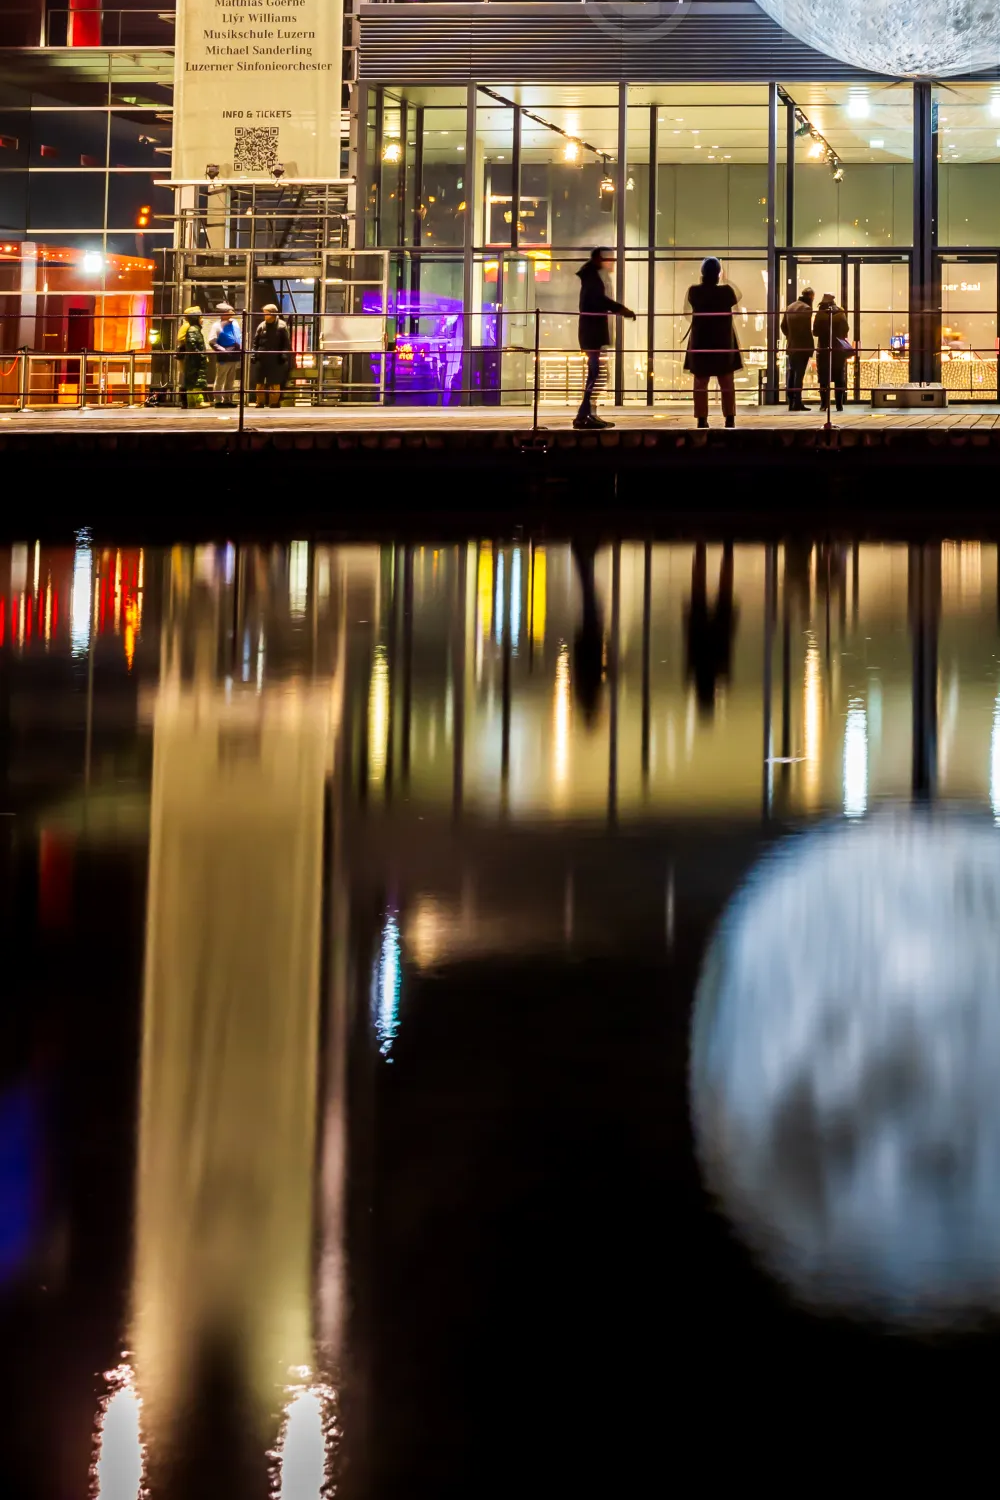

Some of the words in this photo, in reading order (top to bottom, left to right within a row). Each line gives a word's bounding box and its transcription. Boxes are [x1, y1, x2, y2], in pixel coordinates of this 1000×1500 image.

[248, 14, 297, 23] Williams
[203, 29, 274, 39] Musikschule
[277, 29, 316, 39] Luzern
[205, 45, 249, 55] Michael
[252, 45, 313, 57] Sanderling
[185, 62, 234, 72] Luzerner
[236, 62, 333, 72] Sinfonieorchester
[222, 110, 244, 118] INFO
[246, 110, 253, 118] &
[256, 110, 292, 118] TICKETS
[960, 282, 981, 291] Saal
